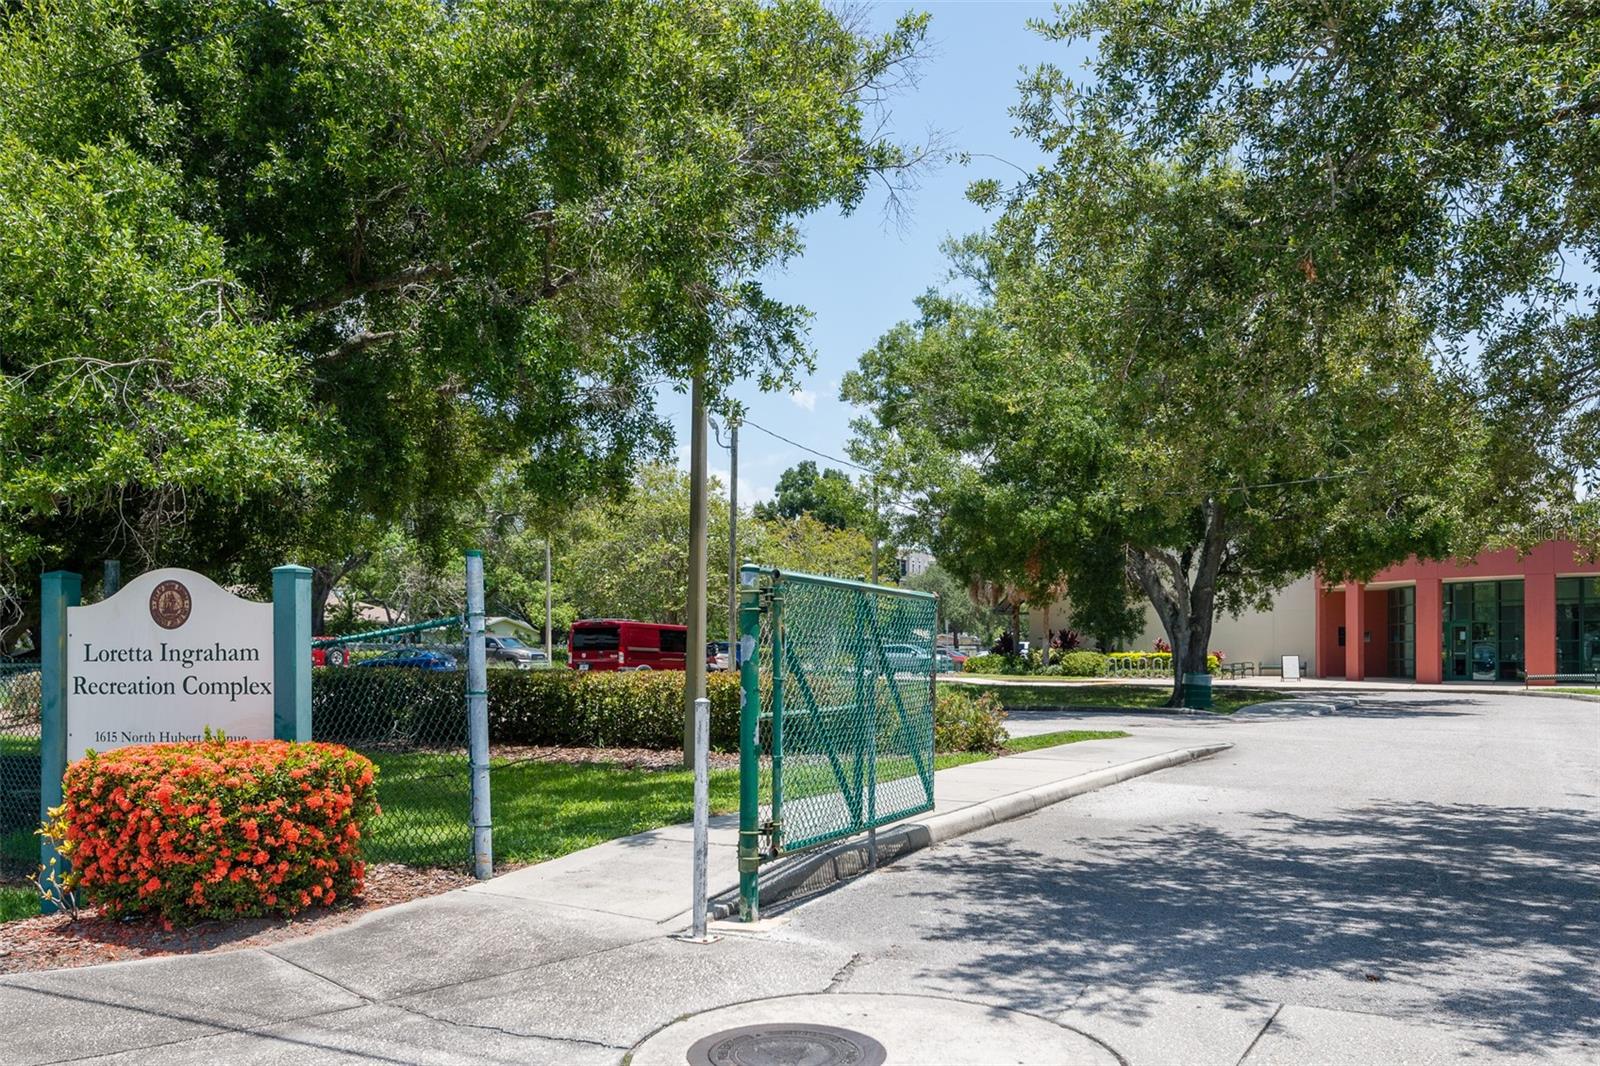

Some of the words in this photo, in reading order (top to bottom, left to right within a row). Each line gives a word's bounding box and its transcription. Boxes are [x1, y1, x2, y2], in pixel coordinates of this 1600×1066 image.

[83, 643, 153, 662] Loretta
[159, 642, 260, 668] Ingraham
[72, 676, 175, 695] Recreation
[182, 675, 273, 702] Complex
[95, 731, 118, 742] 1615
[121, 731, 156, 743] North
[159, 731, 201, 742] Hubert
[204, 732, 248, 742] nue
